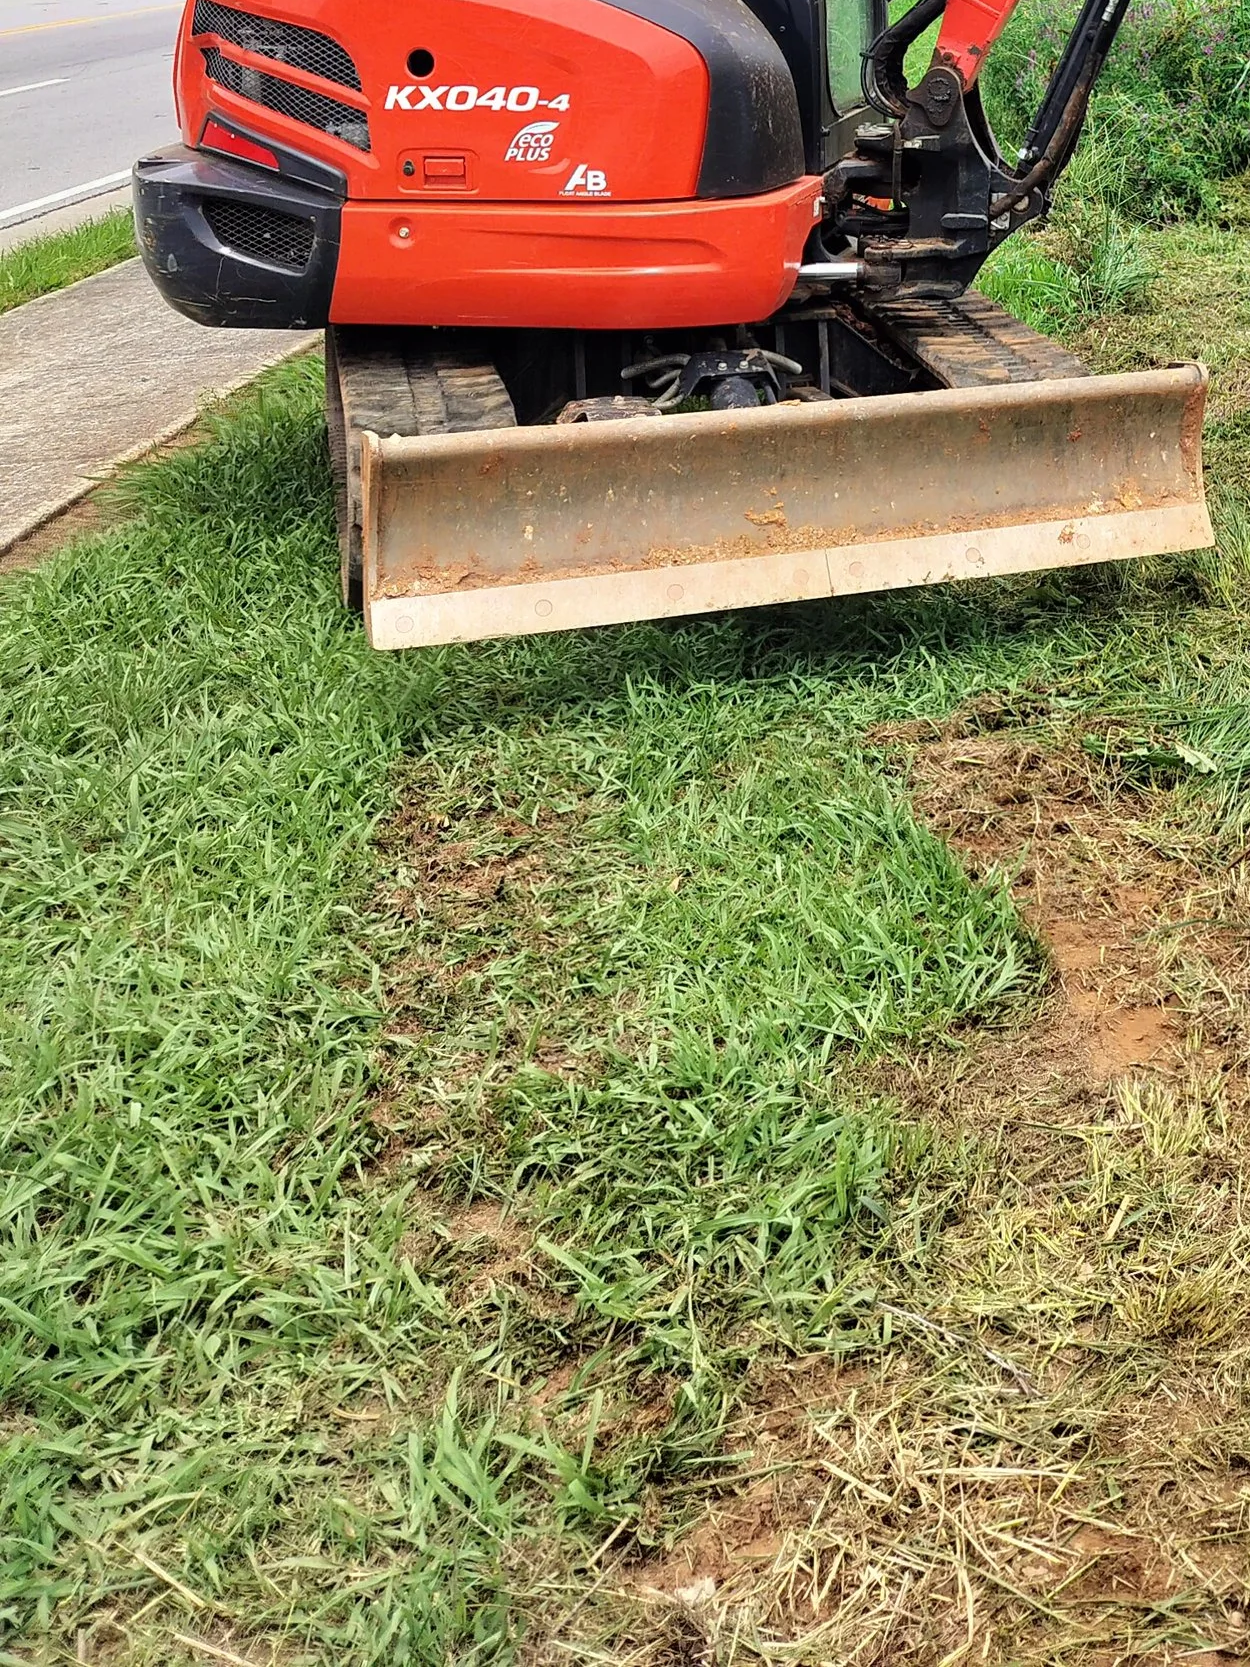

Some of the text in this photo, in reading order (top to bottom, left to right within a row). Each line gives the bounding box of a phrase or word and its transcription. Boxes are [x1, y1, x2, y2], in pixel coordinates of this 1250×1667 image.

[384, 85, 570, 112] KX040-4
[518, 133, 554, 148] eco
[504, 147, 551, 162] PLUS
[563, 163, 608, 191] AB
